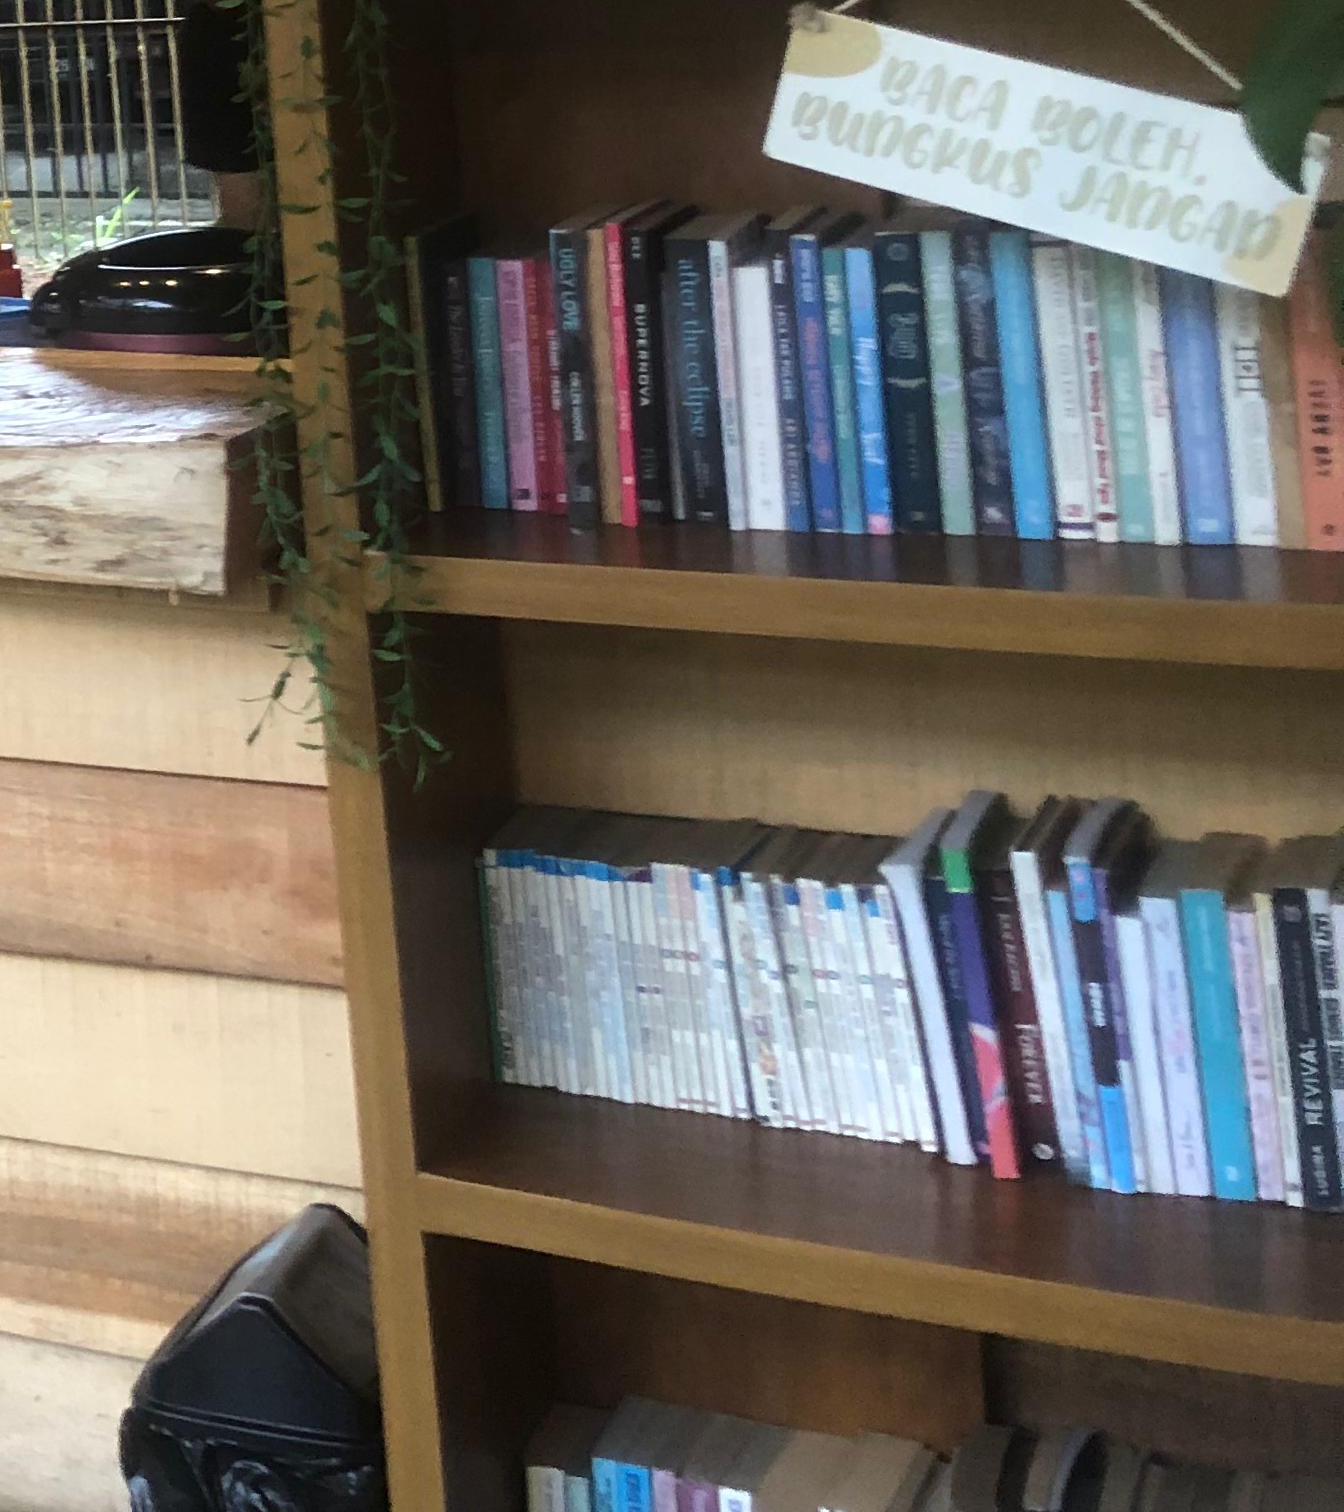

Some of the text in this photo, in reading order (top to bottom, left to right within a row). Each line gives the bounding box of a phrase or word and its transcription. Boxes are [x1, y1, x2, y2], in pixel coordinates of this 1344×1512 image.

[879, 55, 1010, 132] BACA
[790, 91, 1283, 261] BUNGKUS JANGAN
[558, 247, 582, 331] UGLY LOVE
[634, 302, 651, 407] SUPERNOVA
[677, 258, 711, 438] after the eclipse
[1299, 1038, 1326, 1126] REVIVAL
